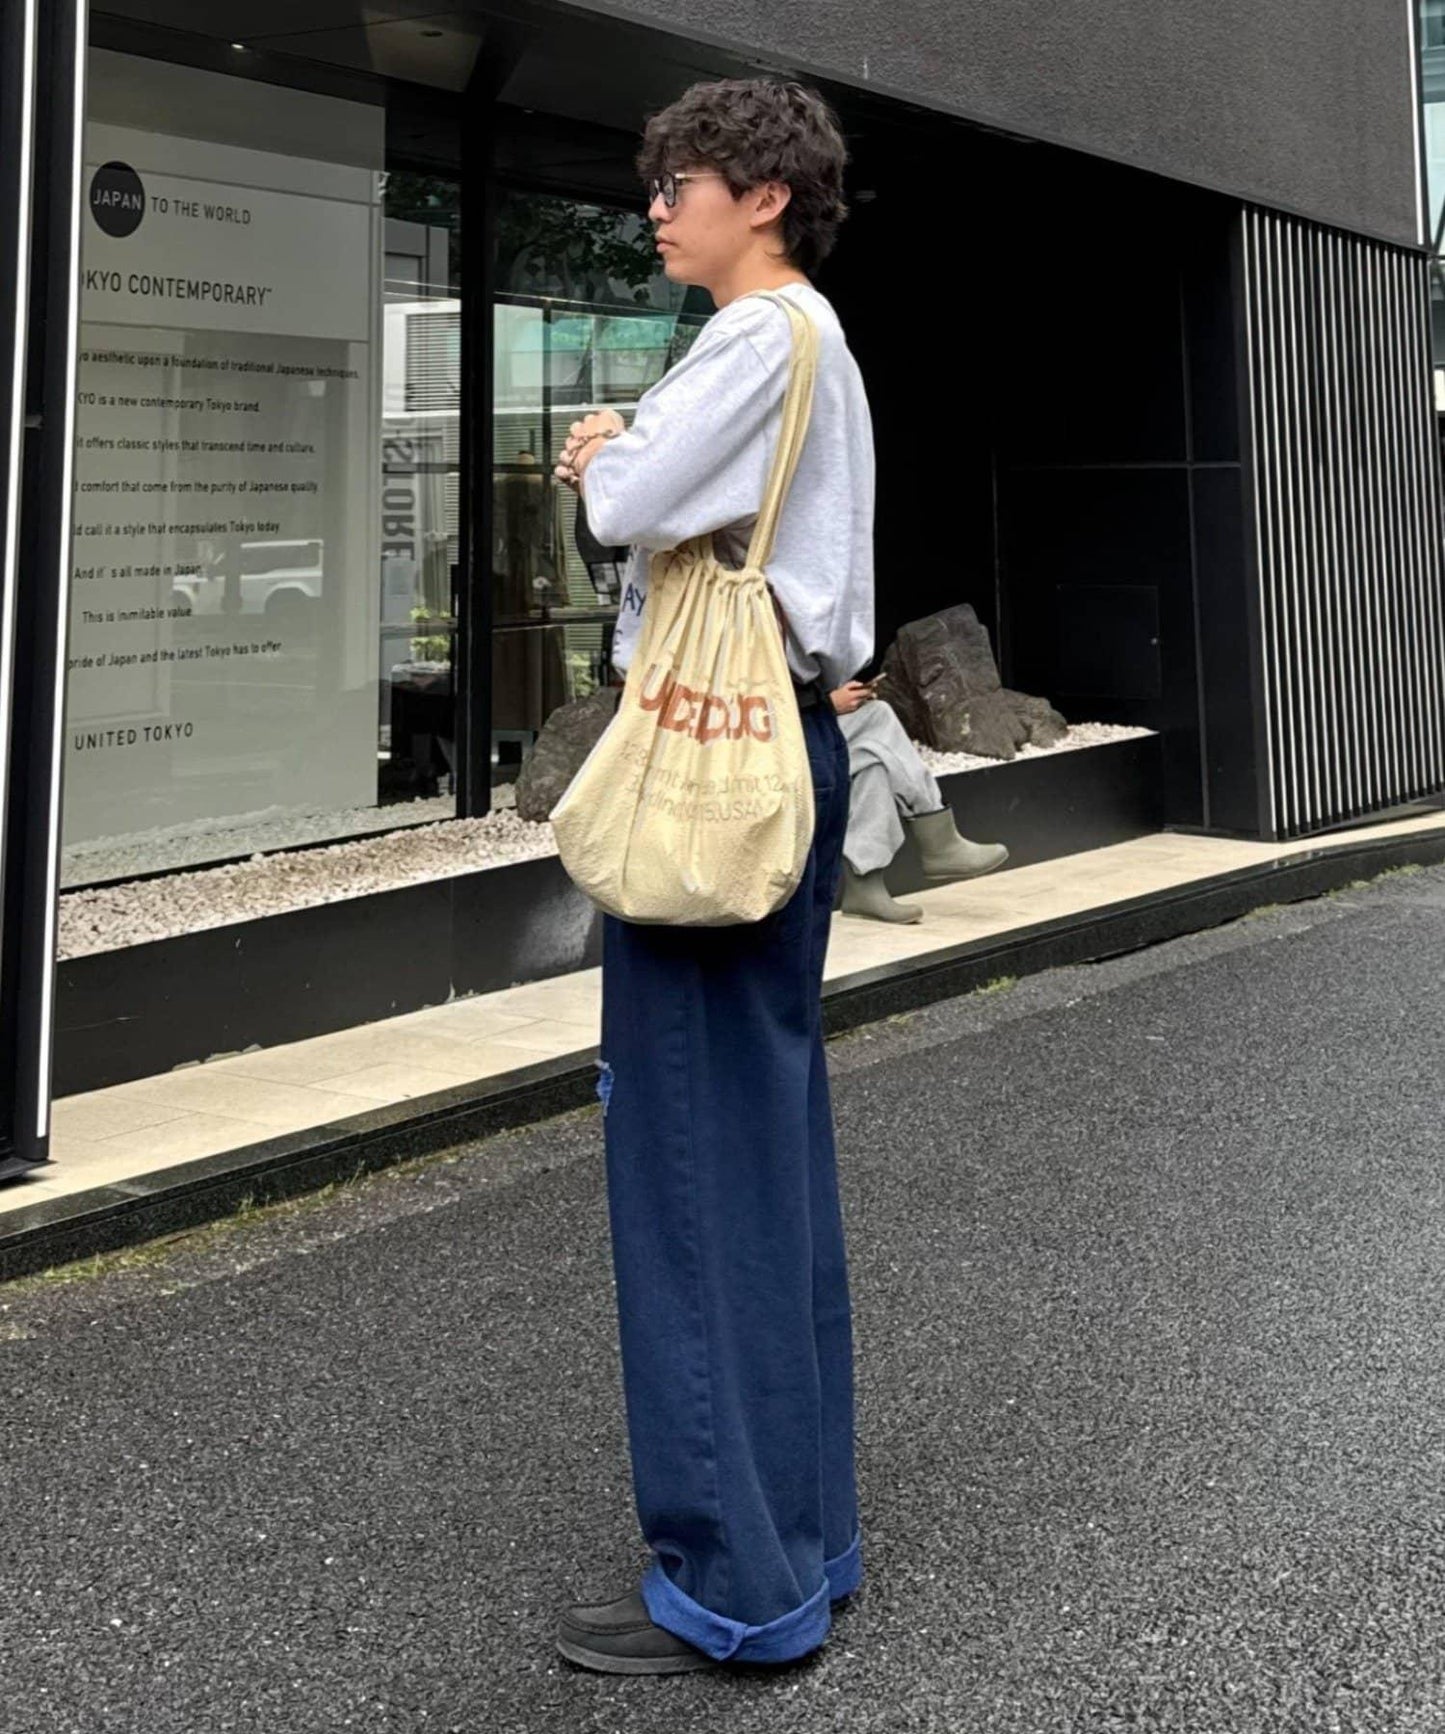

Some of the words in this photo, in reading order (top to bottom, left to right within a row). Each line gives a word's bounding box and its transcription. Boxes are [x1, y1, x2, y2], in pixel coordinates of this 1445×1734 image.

[93, 189, 142, 211] JAPAN
[150, 196, 169, 214] TO
[172, 199, 200, 218] THE
[202, 203, 252, 225] WORLD
[91, 351, 136, 365] aesthetic
[137, 354, 162, 369] upon
[163, 356, 170, 367] a
[170, 354, 219, 370] foundation
[220, 359, 230, 371] of
[230, 360, 275, 374] traditional
[276, 363, 315, 377] Japanese
[97, 394, 108, 406] is
[109, 396, 116, 406] a
[118, 396, 138, 407] new
[140, 397, 204, 412] contemporary
[205, 396, 232, 413] Tokyo
[85, 436, 115, 450] offers
[116, 437, 151, 451] classic
[151, 438, 181, 454] styles
[181, 439, 200, 451] that
[200, 440, 245, 452] transcend
[267, 442, 285, 453] and
[80, 480, 120, 493] comfort
[121, 480, 140, 493] that
[141, 482, 169, 493] come
[169, 480, 193, 493] from
[193, 480, 209, 493] the
[210, 480, 237, 496] purity
[238, 479, 248, 492] of
[249, 480, 290, 496] Japanese
[84, 522, 103, 536] call
[114, 524, 121, 535] a
[122, 521, 147, 539] style
[147, 521, 167, 535] that
[168, 520, 228, 537] encapsulates
[228, 519, 256, 536] Tokyo
[73, 566, 95, 580] And
[133, 564, 161, 577] made
[162, 564, 173, 577] in
[82, 609, 104, 624] This
[105, 611, 115, 623] is
[167, 606, 193, 619] value
[95, 652, 107, 668] of
[108, 651, 138, 668] Japan
[139, 649, 159, 664] and
[159, 649, 176, 662] the
[177, 646, 203, 661] latest
[204, 644, 232, 660] Tokyo
[232, 642, 250, 656] has
[260, 640, 284, 655] offer
[74, 729, 137, 751] UNITED
[143, 721, 194, 743] TOKYO
